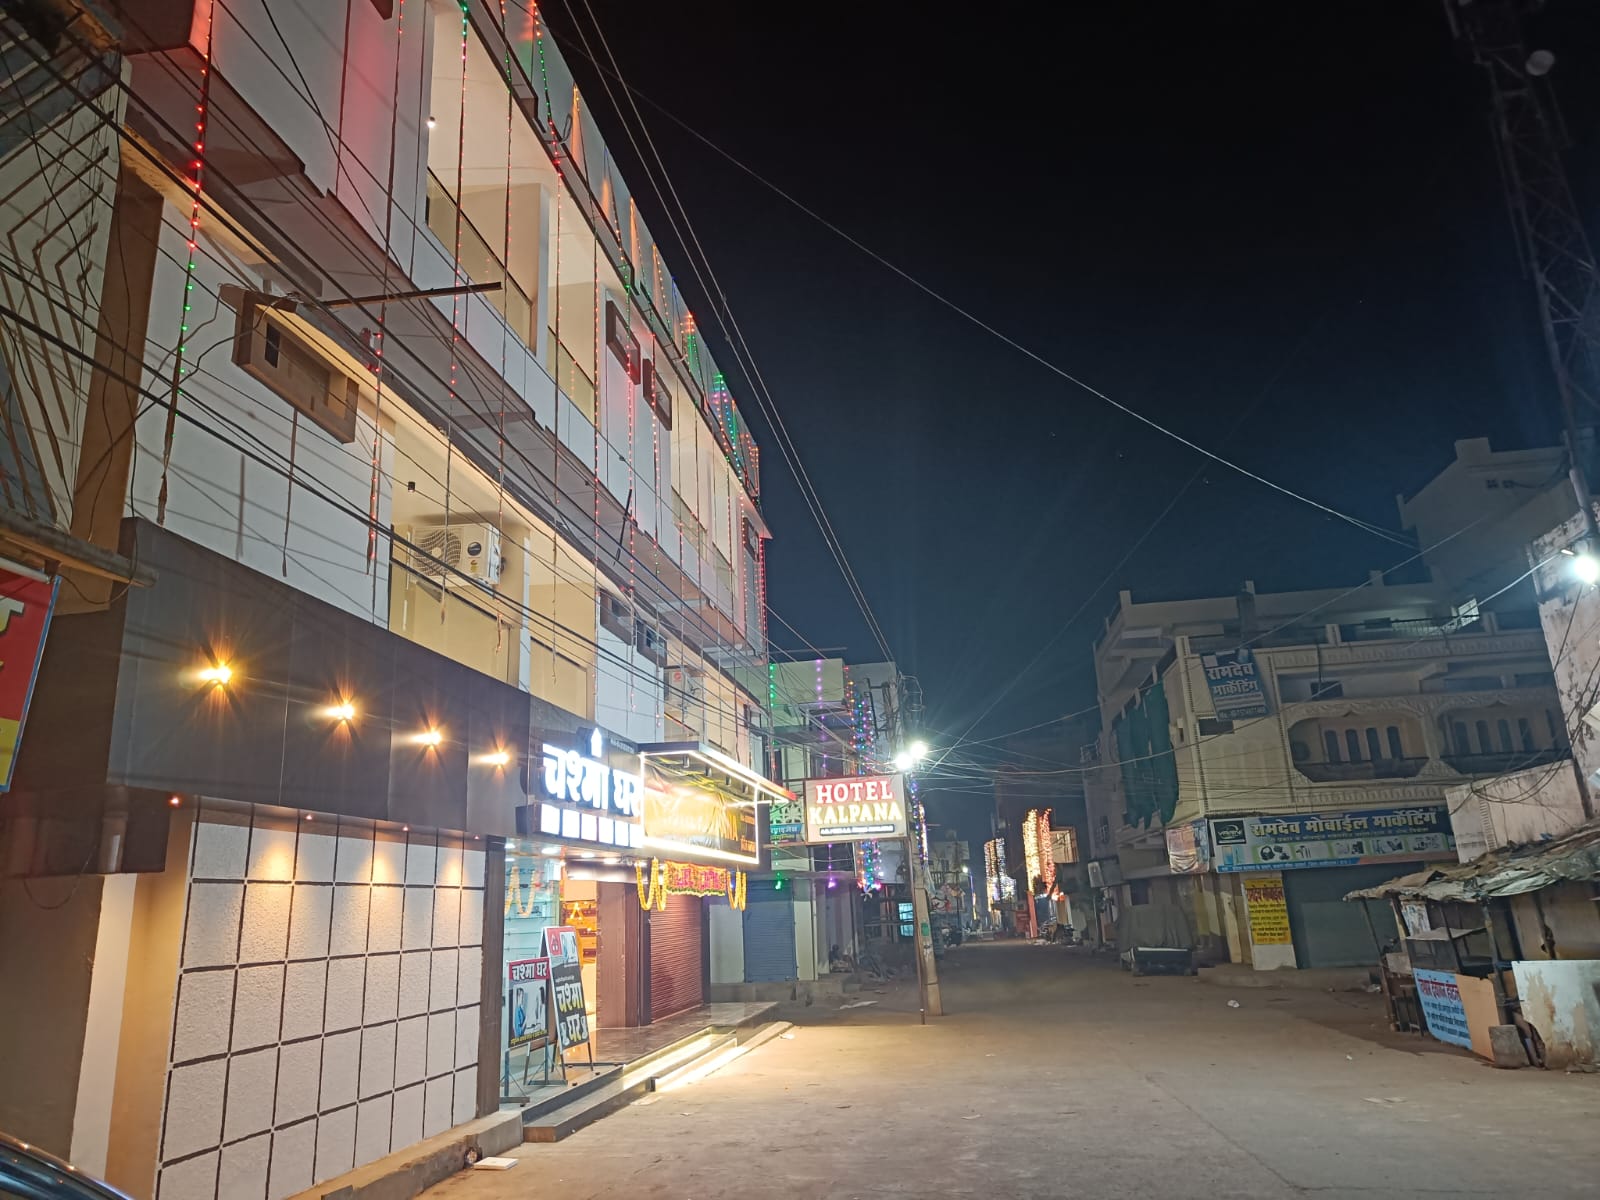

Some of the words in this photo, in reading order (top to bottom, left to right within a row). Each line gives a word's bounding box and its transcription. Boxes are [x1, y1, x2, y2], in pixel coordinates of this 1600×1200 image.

[1206, 662, 1253, 680] रामदेव
[1212, 678, 1258, 695] मार्केटिंग
[542, 743, 610, 810] चश्मा
[816, 780, 893, 804] HOTEL
[809, 802, 902, 825] KALPANA
[1250, 819, 1301, 837] रामदेव
[1304, 815, 1369, 834] मोबाईल
[1372, 809, 1437, 828] मार्केटिंग
[512, 963, 535, 981] चश्मा
[537, 961, 548, 978] घर
[555, 983, 583, 1012] चश्मा
[567, 1015, 582, 1042] घर
